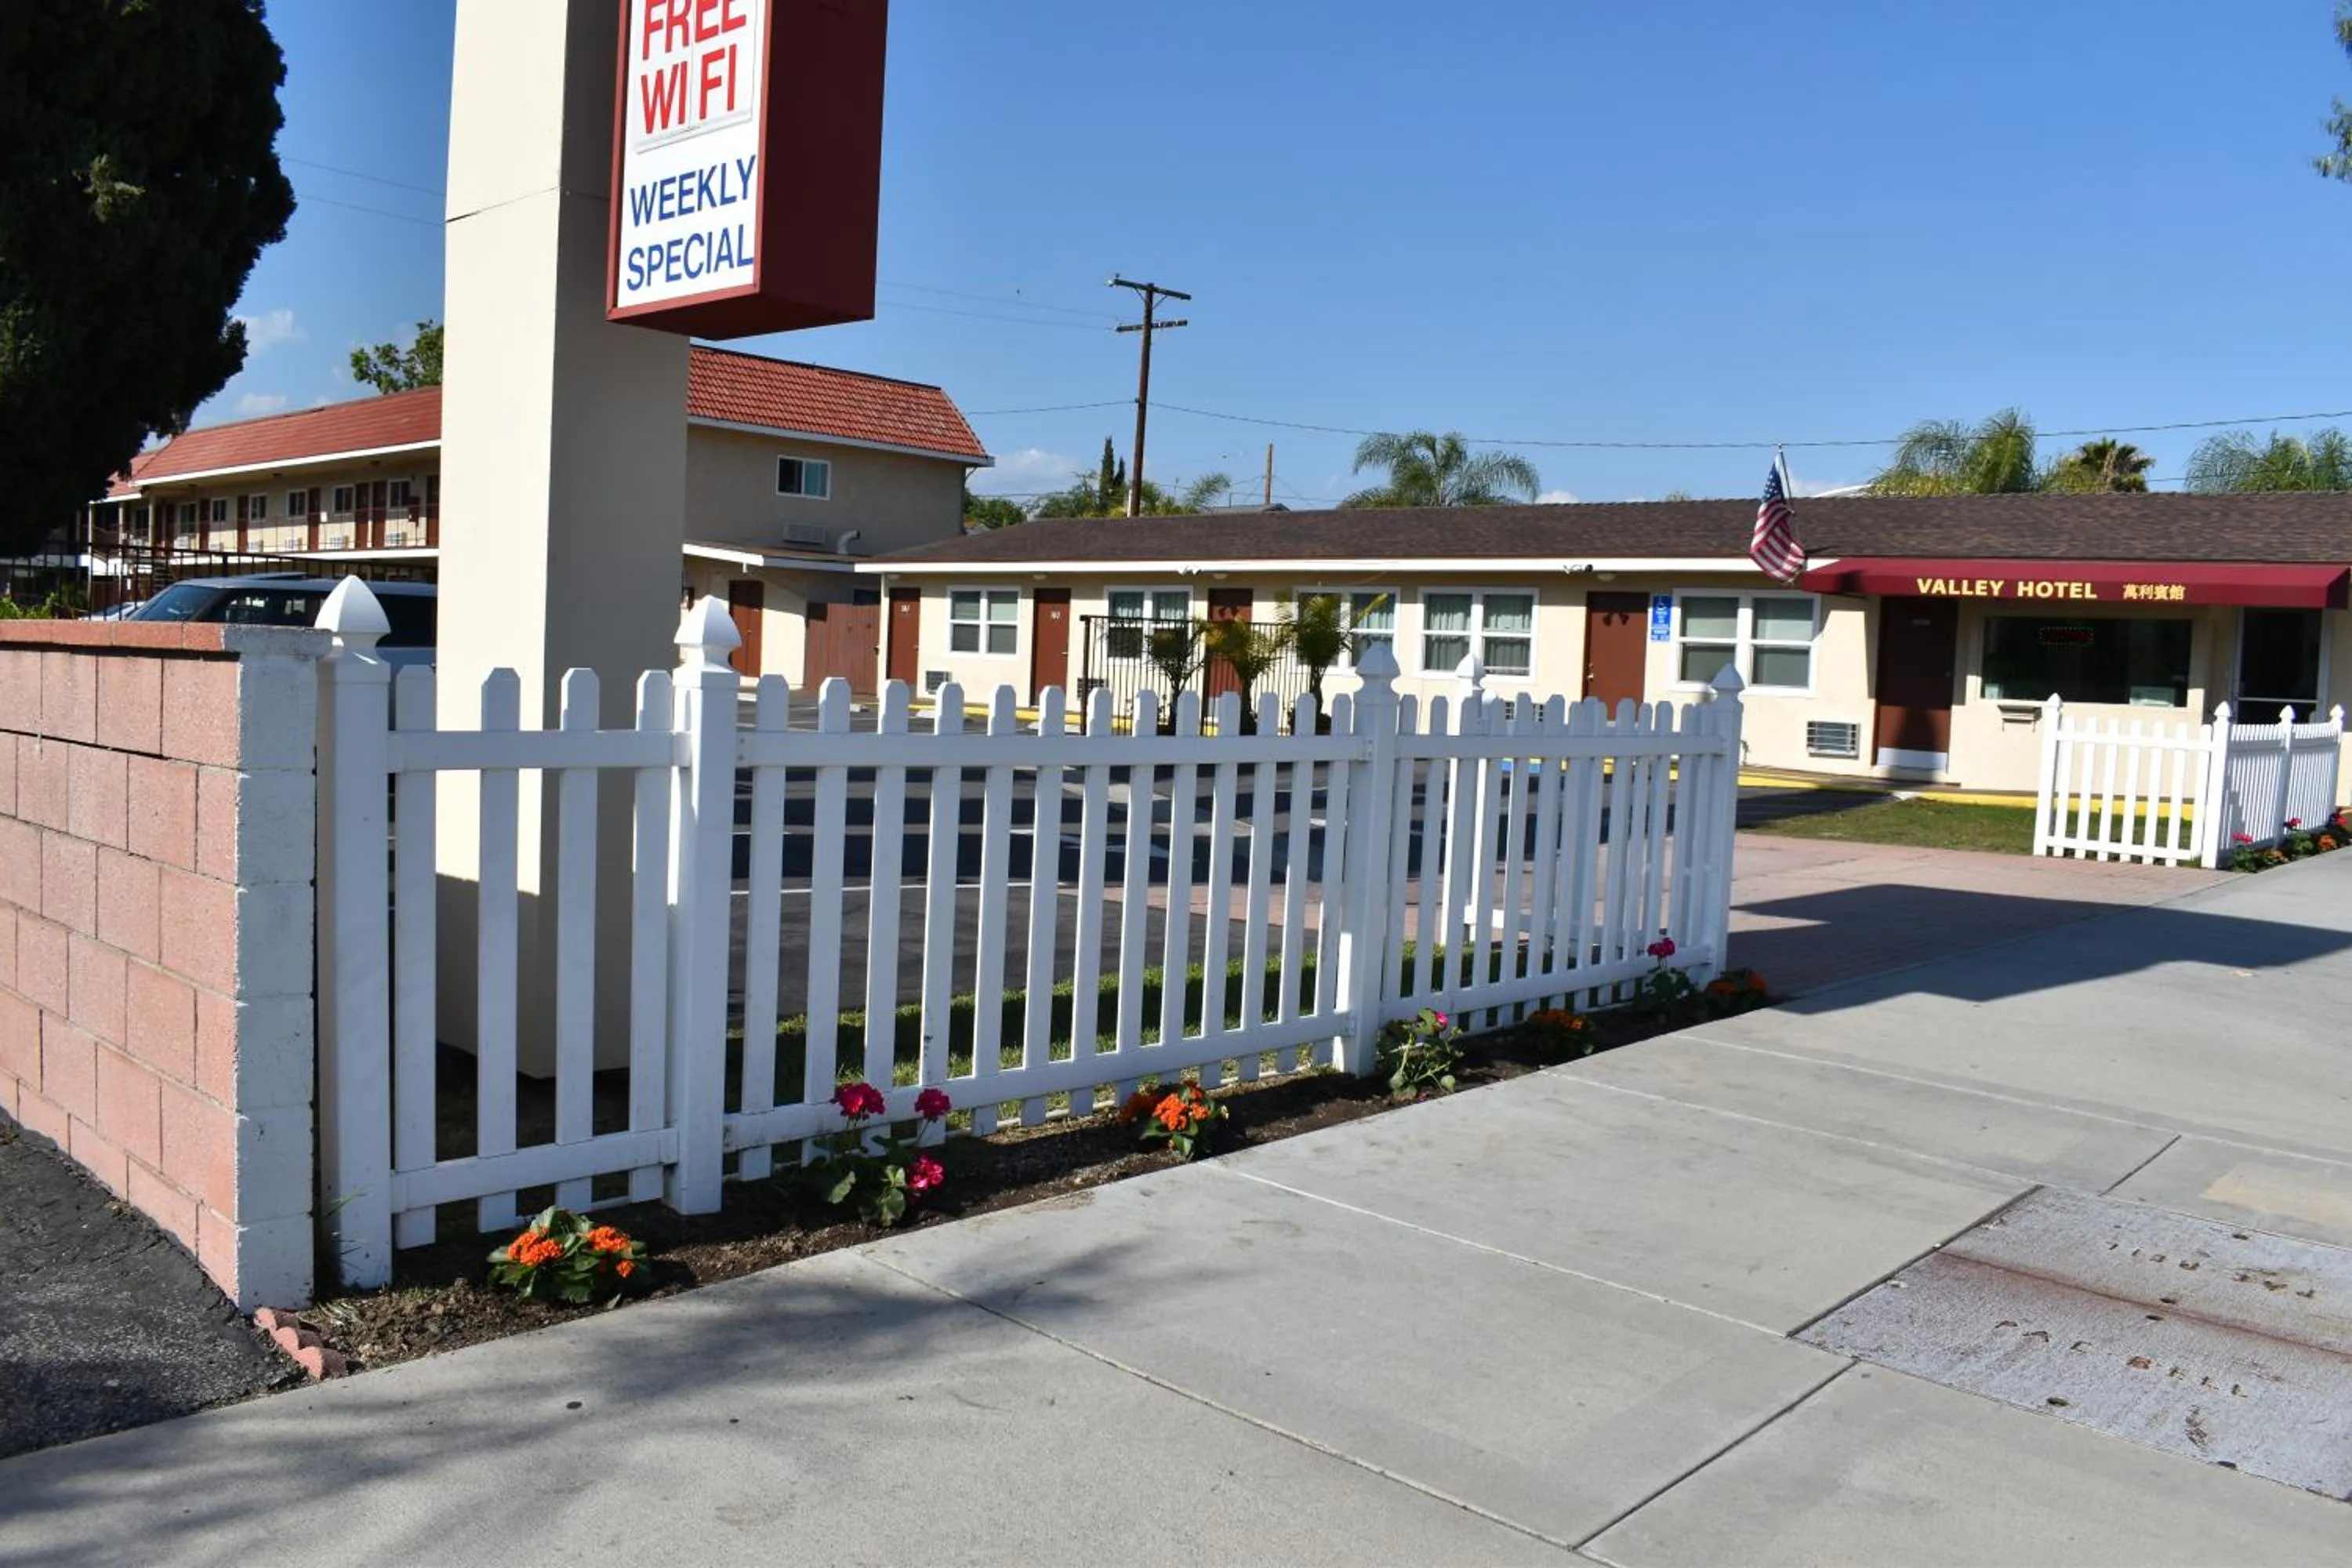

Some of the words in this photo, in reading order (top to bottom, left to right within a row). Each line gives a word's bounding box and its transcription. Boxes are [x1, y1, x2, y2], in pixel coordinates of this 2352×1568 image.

[630, 155, 756, 227] WEEKLY
[627, 224, 754, 291] SPECIAL
[1917, 579, 2005, 596] VALLEY
[2017, 582, 2097, 599] HOTEL
